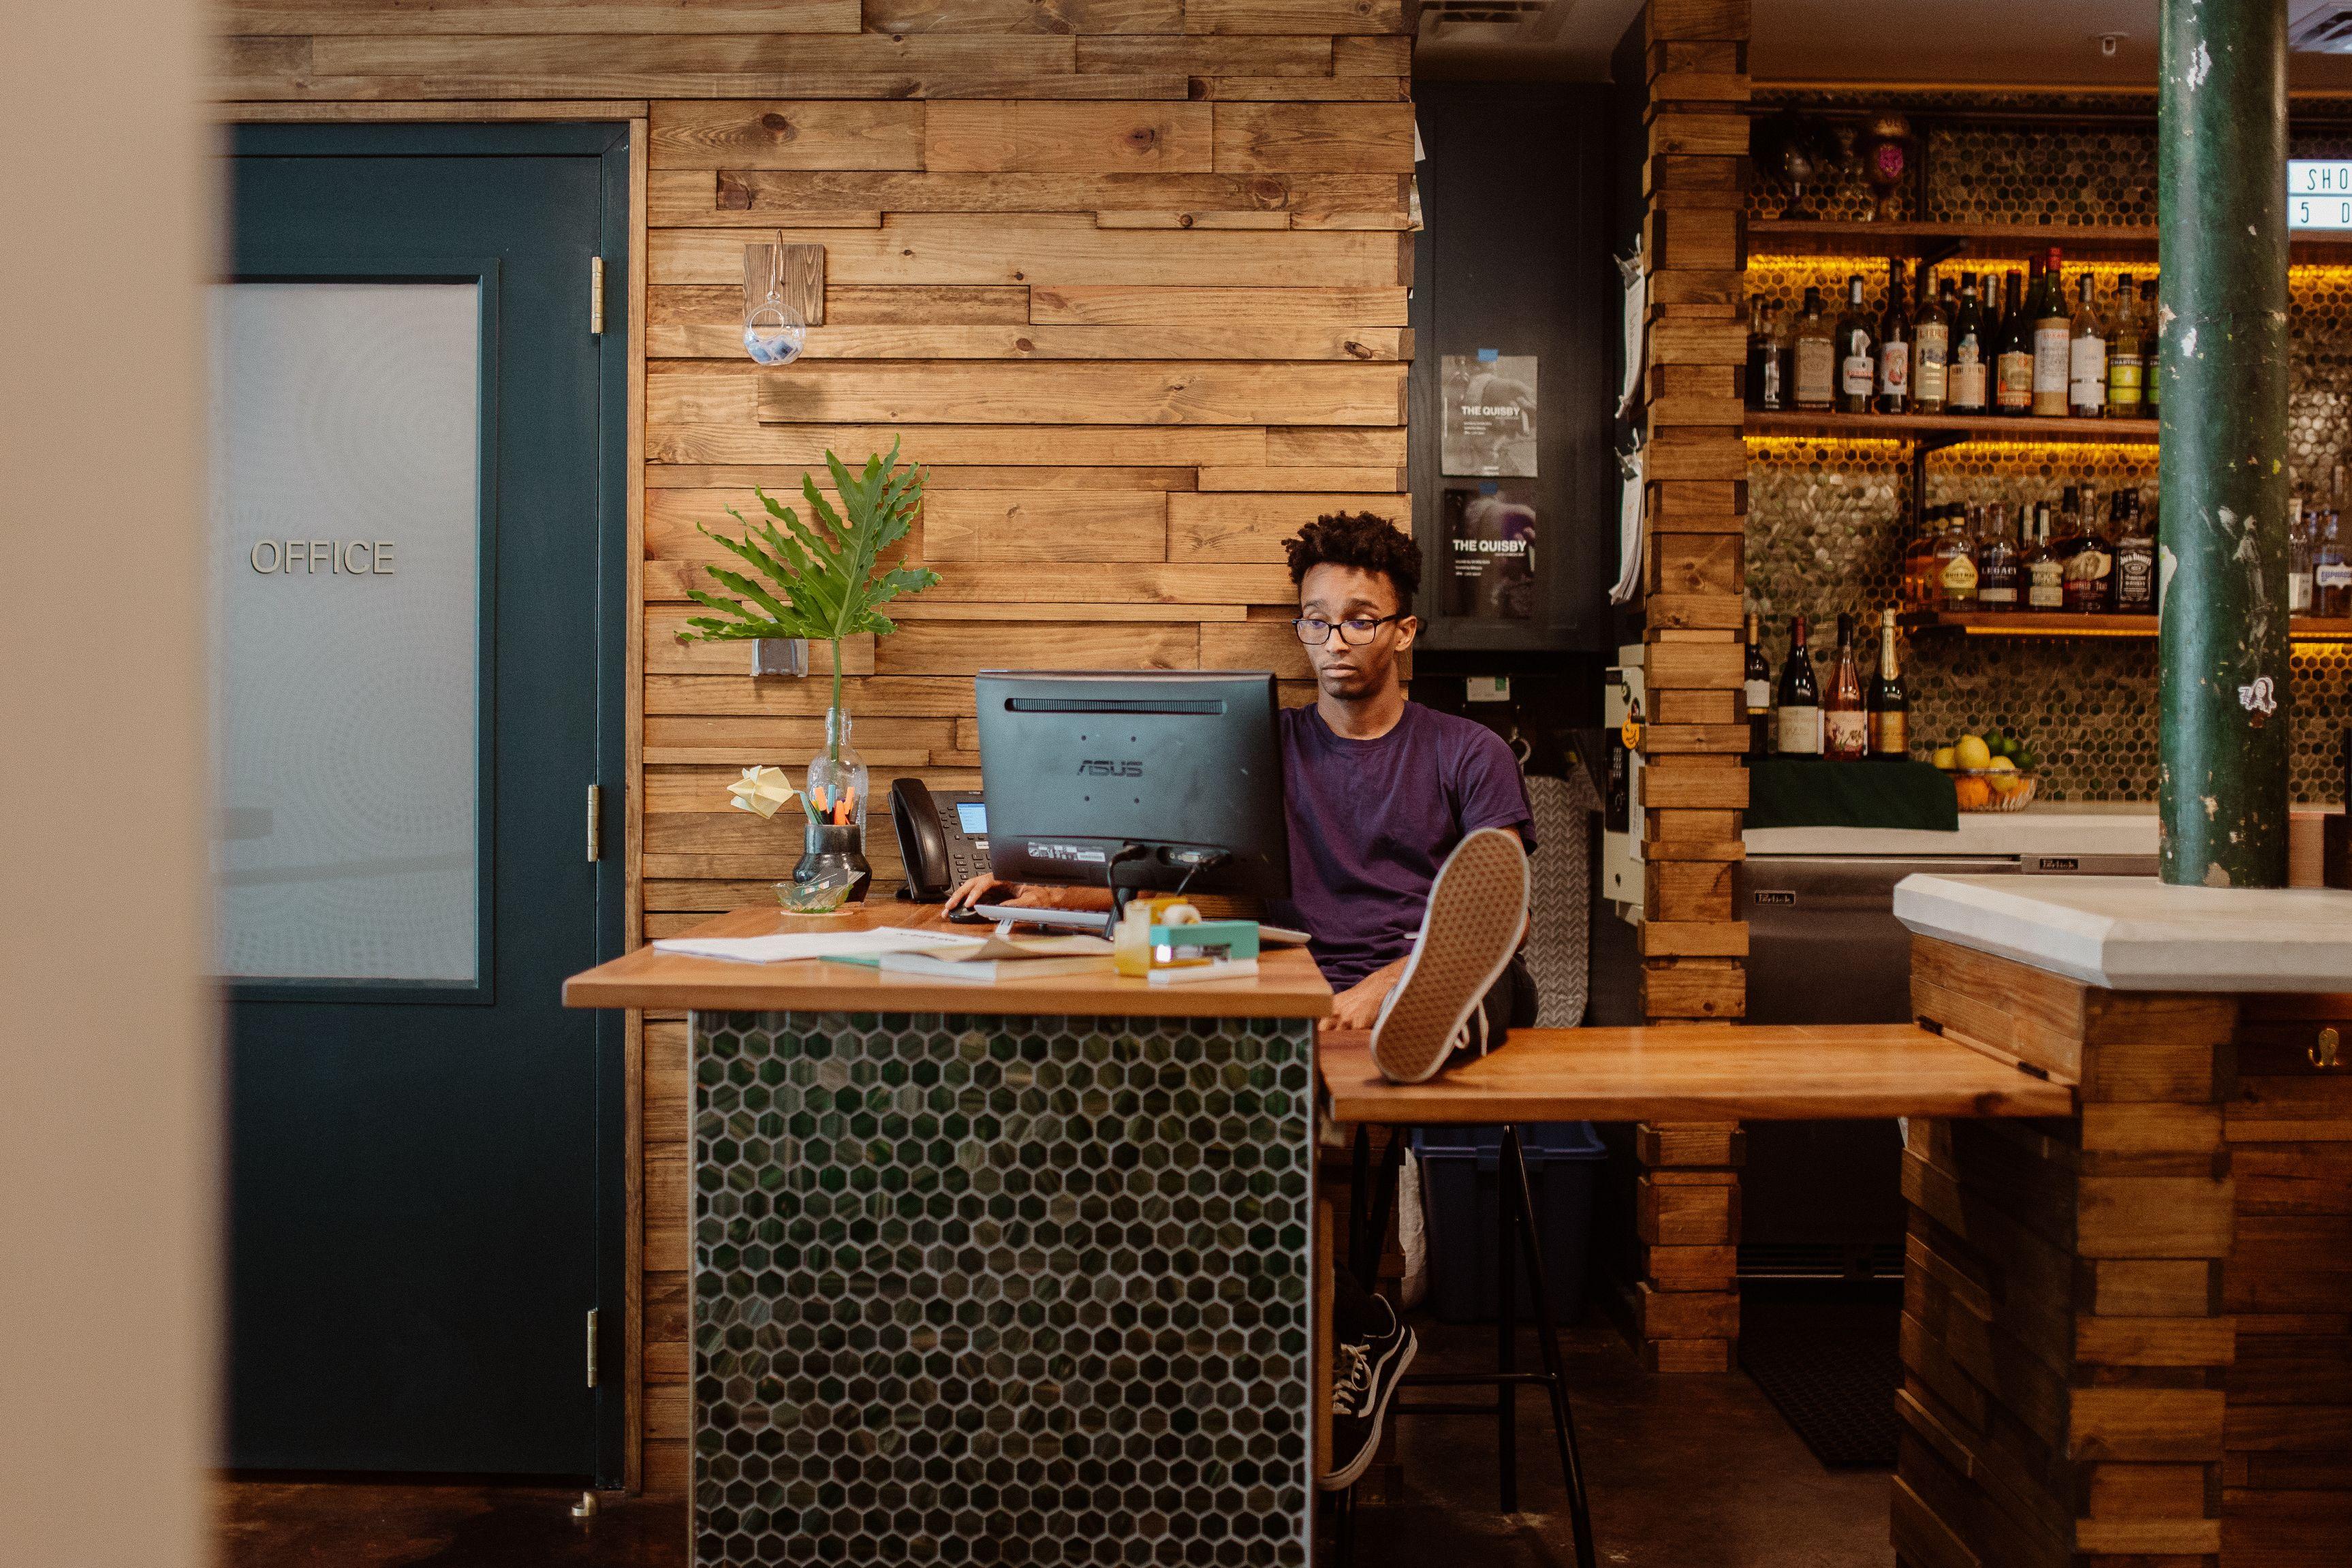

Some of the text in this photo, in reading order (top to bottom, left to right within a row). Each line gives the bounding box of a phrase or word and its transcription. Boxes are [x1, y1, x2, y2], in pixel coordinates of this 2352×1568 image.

[2307, 168, 2348, 191] SHO
[2301, 202, 2309, 223] 5
[1461, 405, 1520, 416] THE QUISBY
[1452, 539, 1527, 553] THE QUISBY
[250, 539, 395, 575] OFFICE
[1077, 759, 1143, 777] ASUS
